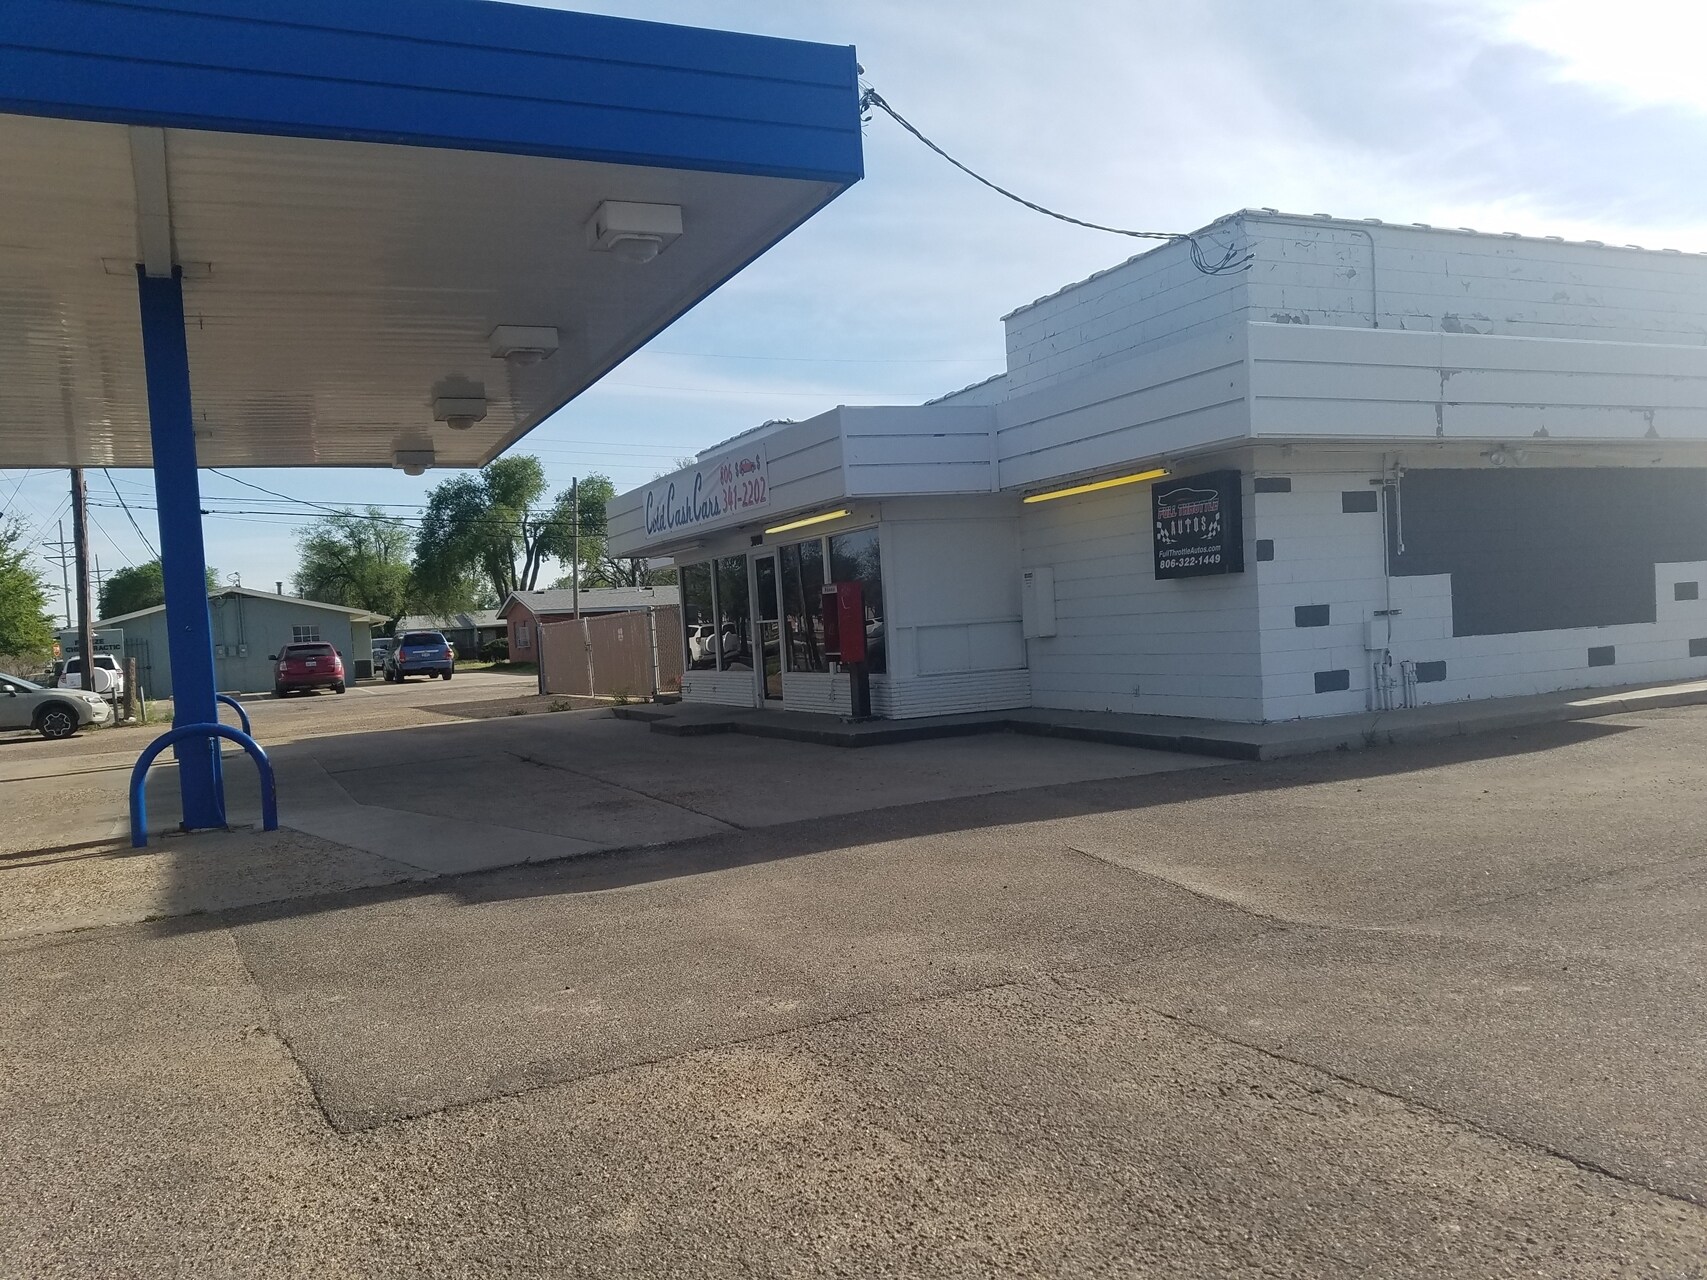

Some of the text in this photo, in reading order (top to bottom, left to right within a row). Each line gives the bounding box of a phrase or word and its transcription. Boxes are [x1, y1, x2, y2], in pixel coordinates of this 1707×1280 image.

[720, 463, 733, 486] 806
[667, 482, 693, 529] Cash
[693, 473, 721, 520] Cars
[722, 476, 767, 513] 341-2202
[1171, 515, 1207, 536] AUTOS
[1159, 545, 1221, 558] FullThrottleAutos.com
[1160, 553, 1221, 569] 806-322-1449
